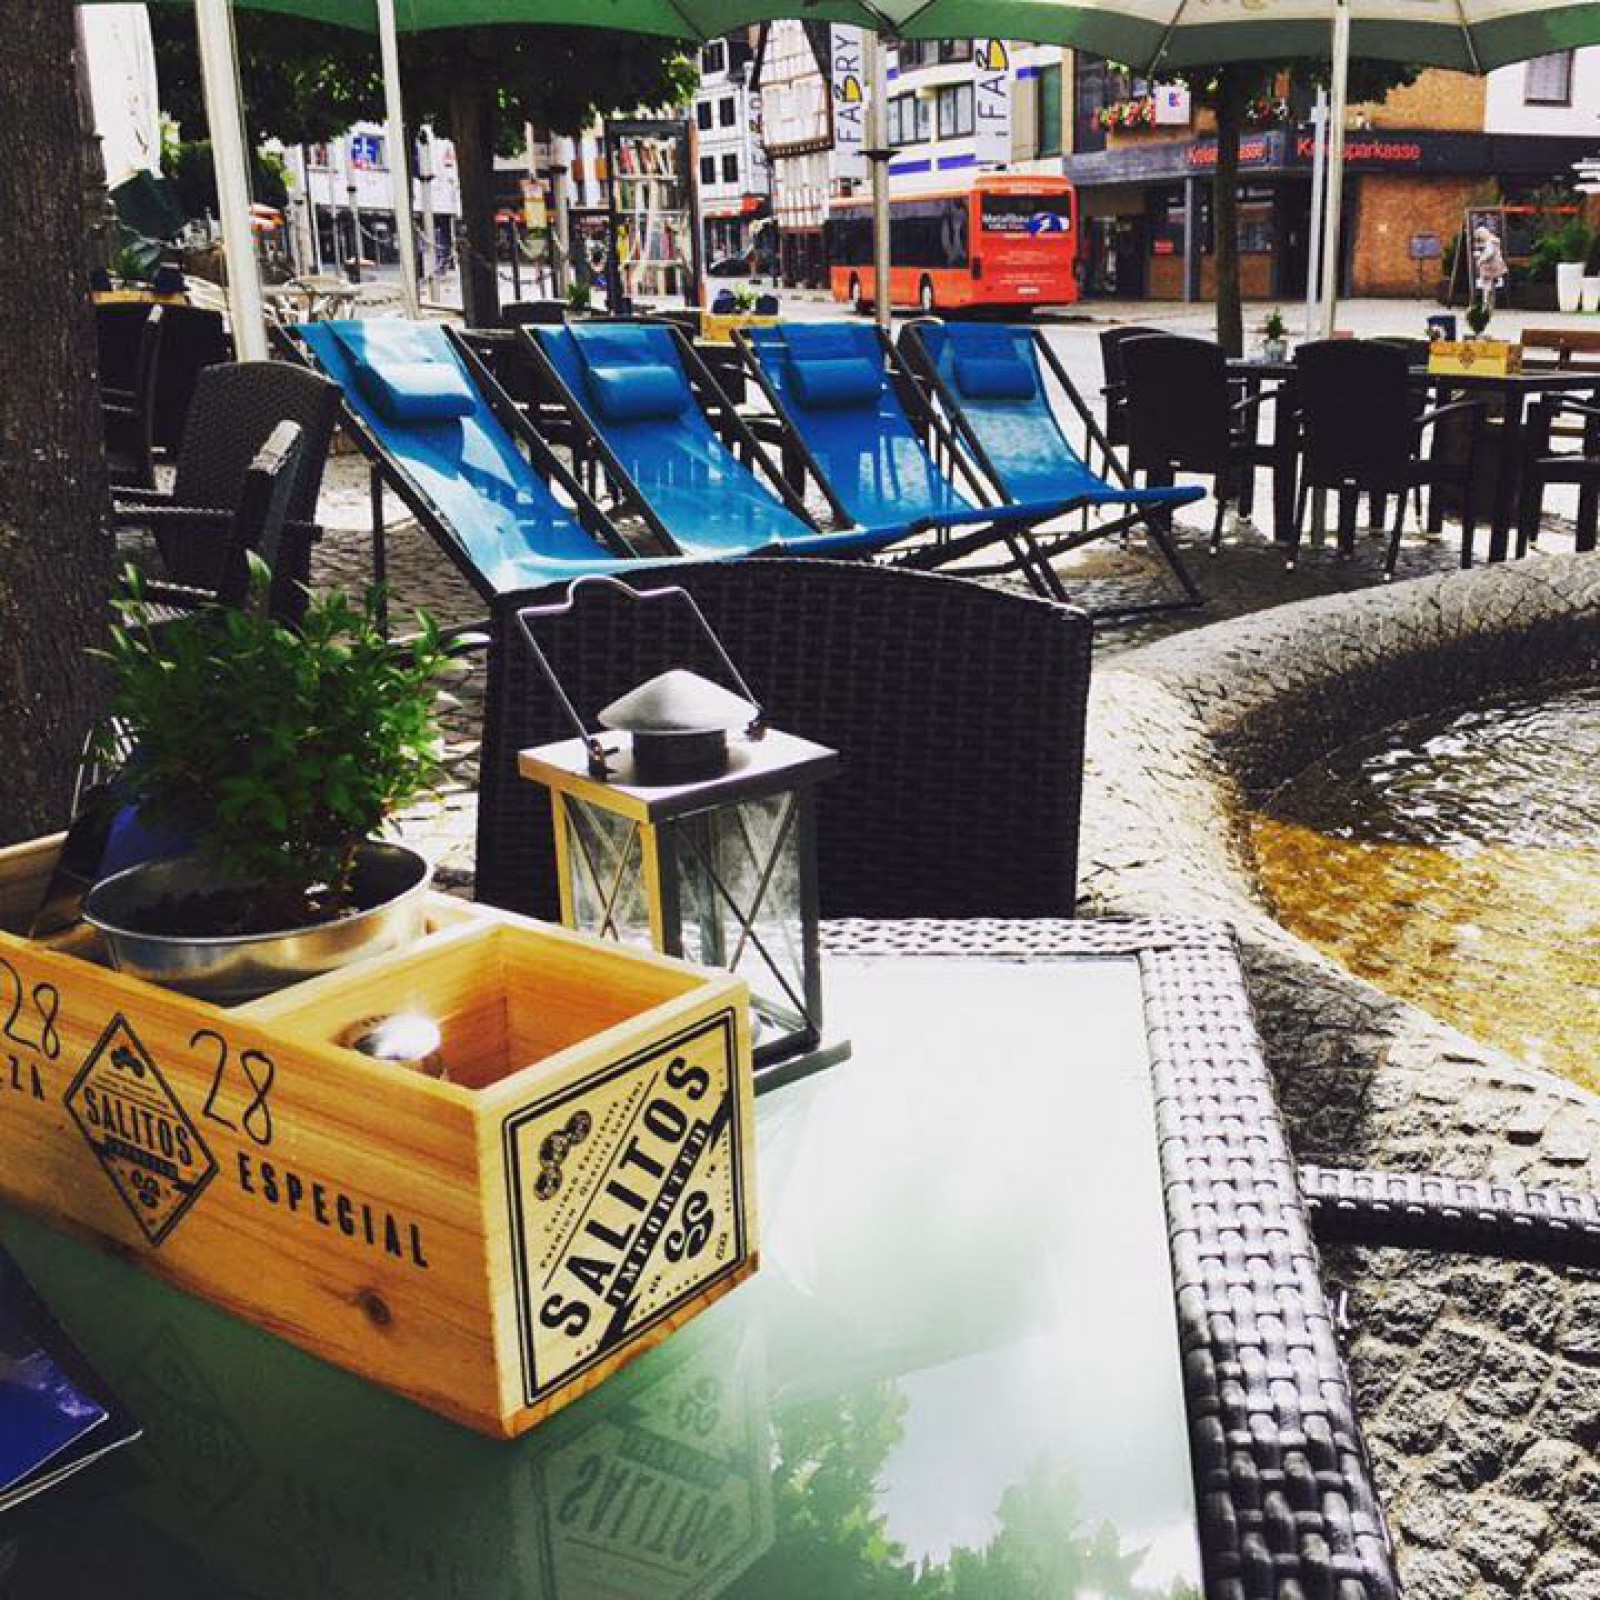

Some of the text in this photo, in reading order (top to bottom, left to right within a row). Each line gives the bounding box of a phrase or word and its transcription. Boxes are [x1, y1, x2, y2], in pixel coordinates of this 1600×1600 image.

[0, 1053, 46, 1102] ZA
[84, 1086, 192, 1166] SALITOS
[190, 1029, 275, 1146] 28
[238, 1152, 428, 1268] ESPECIAL
[540, 1056, 710, 1338] SALITOS
[608, 1122, 711, 1305] IMPORTED
